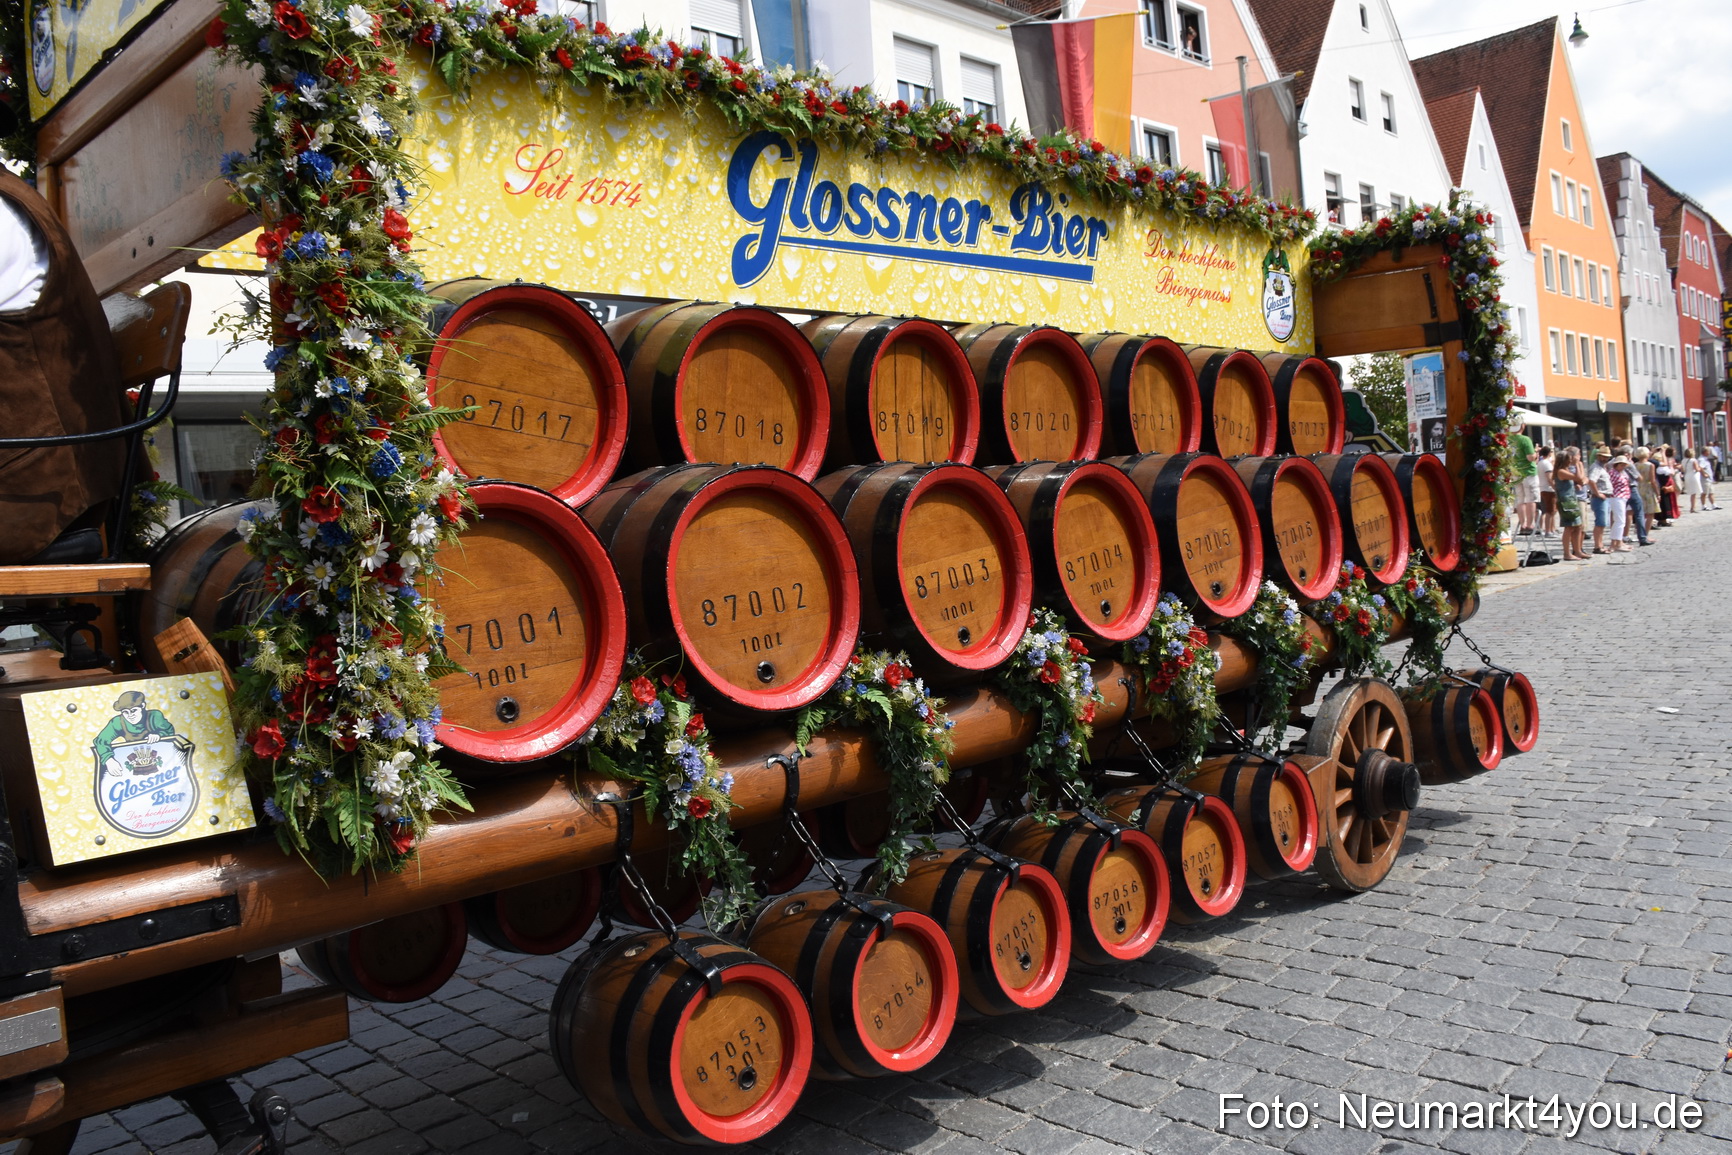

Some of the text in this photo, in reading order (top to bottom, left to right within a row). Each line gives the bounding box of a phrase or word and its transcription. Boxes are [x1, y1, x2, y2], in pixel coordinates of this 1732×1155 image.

[504, 143, 643, 209] Seit 1574
[727, 130, 1109, 288] Glossner-Bier
[1144, 229, 1238, 277] Der hochfeine
[1155, 265, 1232, 308] Biergenuss
[462, 394, 572, 440] 87017
[696, 408, 784, 446] 87018
[878, 411, 944, 437] 87019
[1010, 412, 1070, 432] 87020
[1132, 413, 1175, 432] 87021
[1291, 420, 1325, 437] 87023
[1185, 529, 1231, 560] 87005
[1275, 521, 1312, 551] 87006
[1355, 514, 1385, 539] 87007
[915, 558, 990, 599] 87003
[1065, 543, 1123, 582] 87004
[702, 582, 807, 628] 87002
[109, 765, 181, 815] Glossner
[151, 788, 186, 806] Bier
[1183, 843, 1216, 872] 87057
[1094, 880, 1138, 910] 87056
[996, 909, 1036, 957] 87055
[874, 972, 924, 1030] 87054
[697, 1016, 766, 1083] 87053
